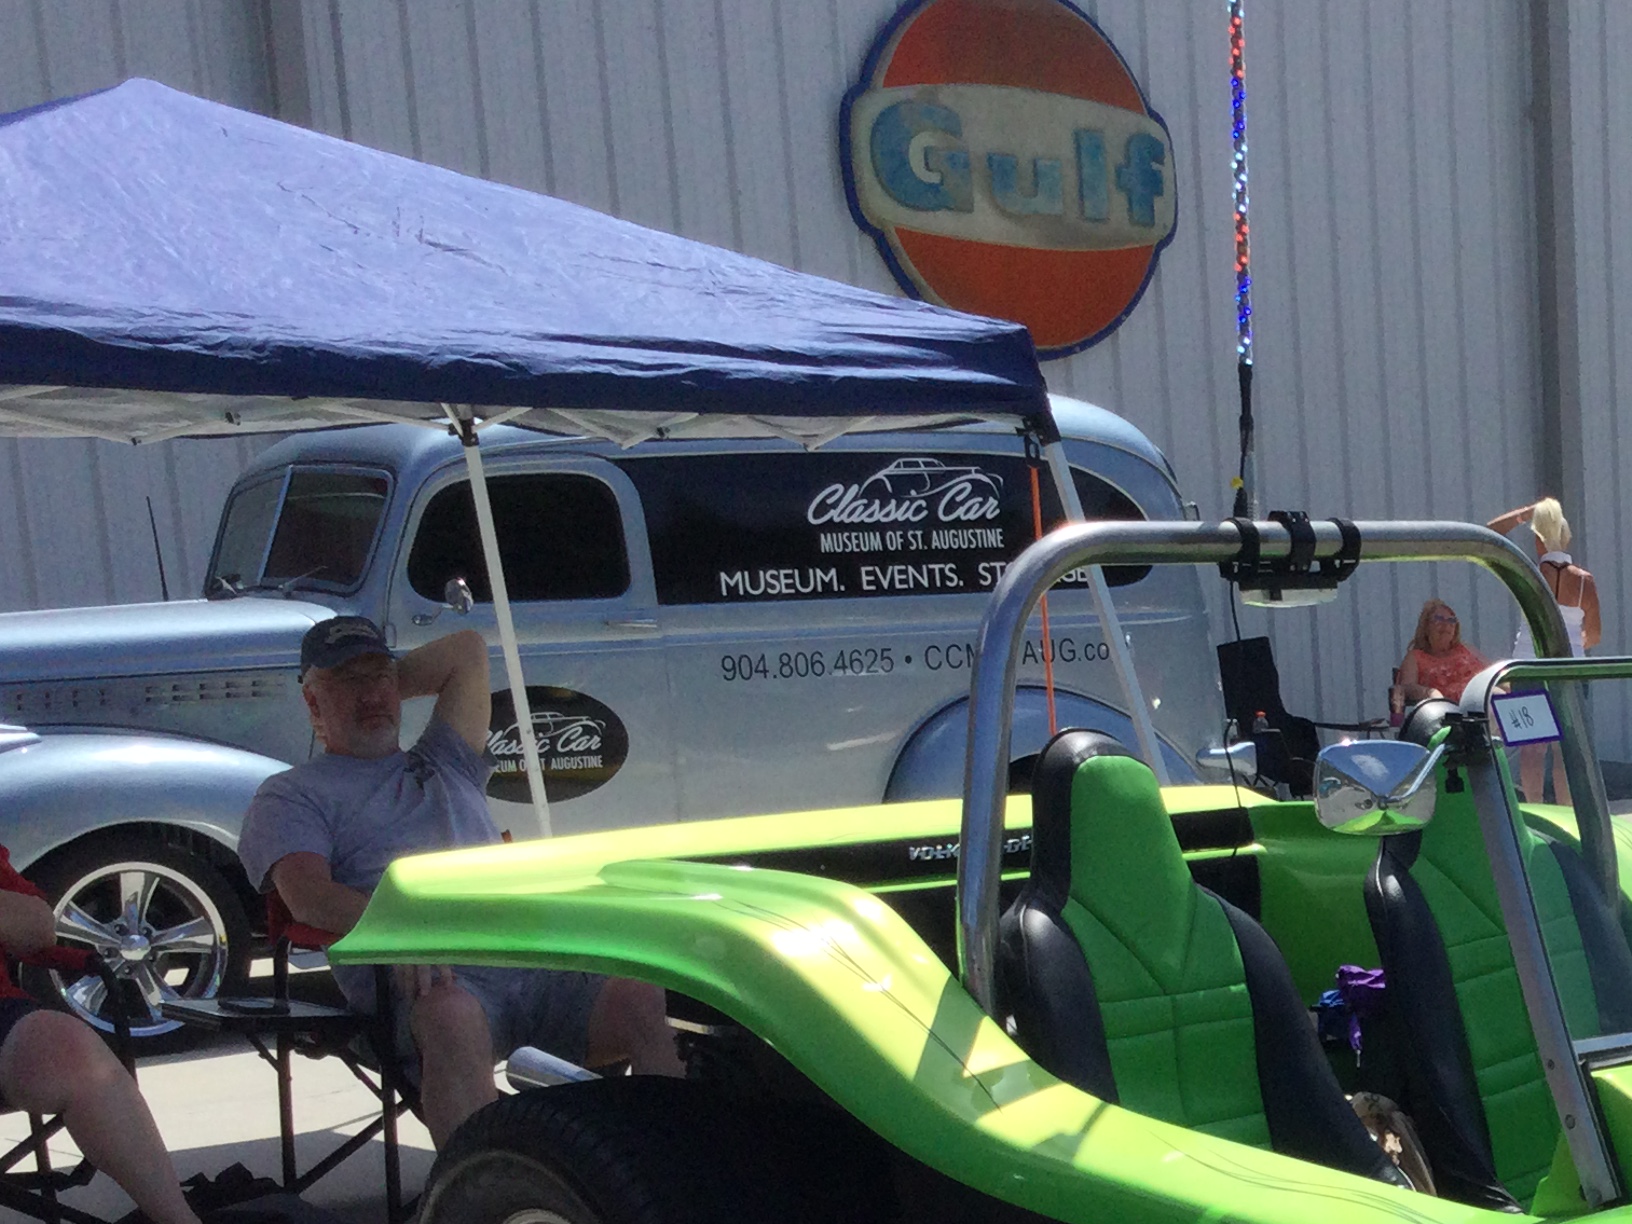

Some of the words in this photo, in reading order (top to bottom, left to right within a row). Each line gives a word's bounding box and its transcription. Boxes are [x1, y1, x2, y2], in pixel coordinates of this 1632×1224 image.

[870, 100, 1166, 228] Gulf
[807, 483, 929, 525] Classic
[937, 481, 1001, 522] Car
[820, 531, 883, 553] MUSEUM
[886, 530, 904, 551] OF
[908, 529, 928, 550] ST.
[931, 528, 1005, 550] AUGUSTINE
[719, 567, 846, 597] MUSEUM.
[861, 562, 965, 591] EVENTS.
[721, 648, 895, 681] 904.806.4625
[1509, 705, 1535, 730] #18
[556, 725, 602, 753] Car
[550, 754, 603, 771] AUGUSTINE
